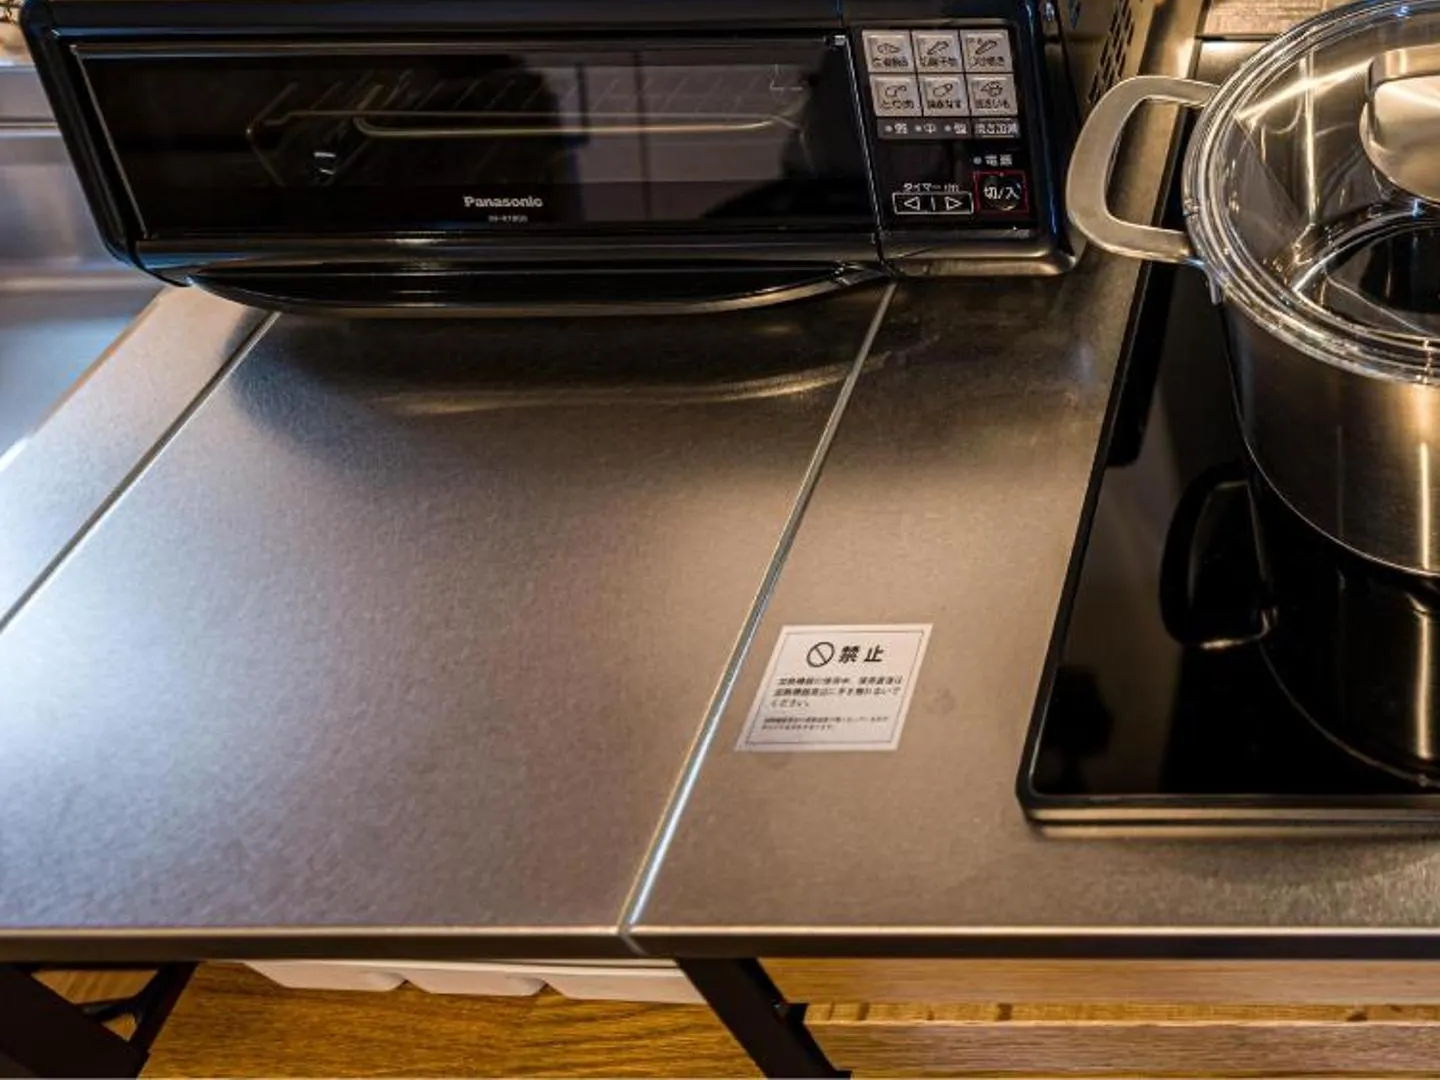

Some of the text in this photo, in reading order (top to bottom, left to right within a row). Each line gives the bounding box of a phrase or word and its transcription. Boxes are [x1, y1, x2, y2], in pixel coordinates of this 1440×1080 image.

[924, 123, 937, 135] 中
[463, 195, 544, 208] Panasonic
[837, 643, 885, 663] 禁止
